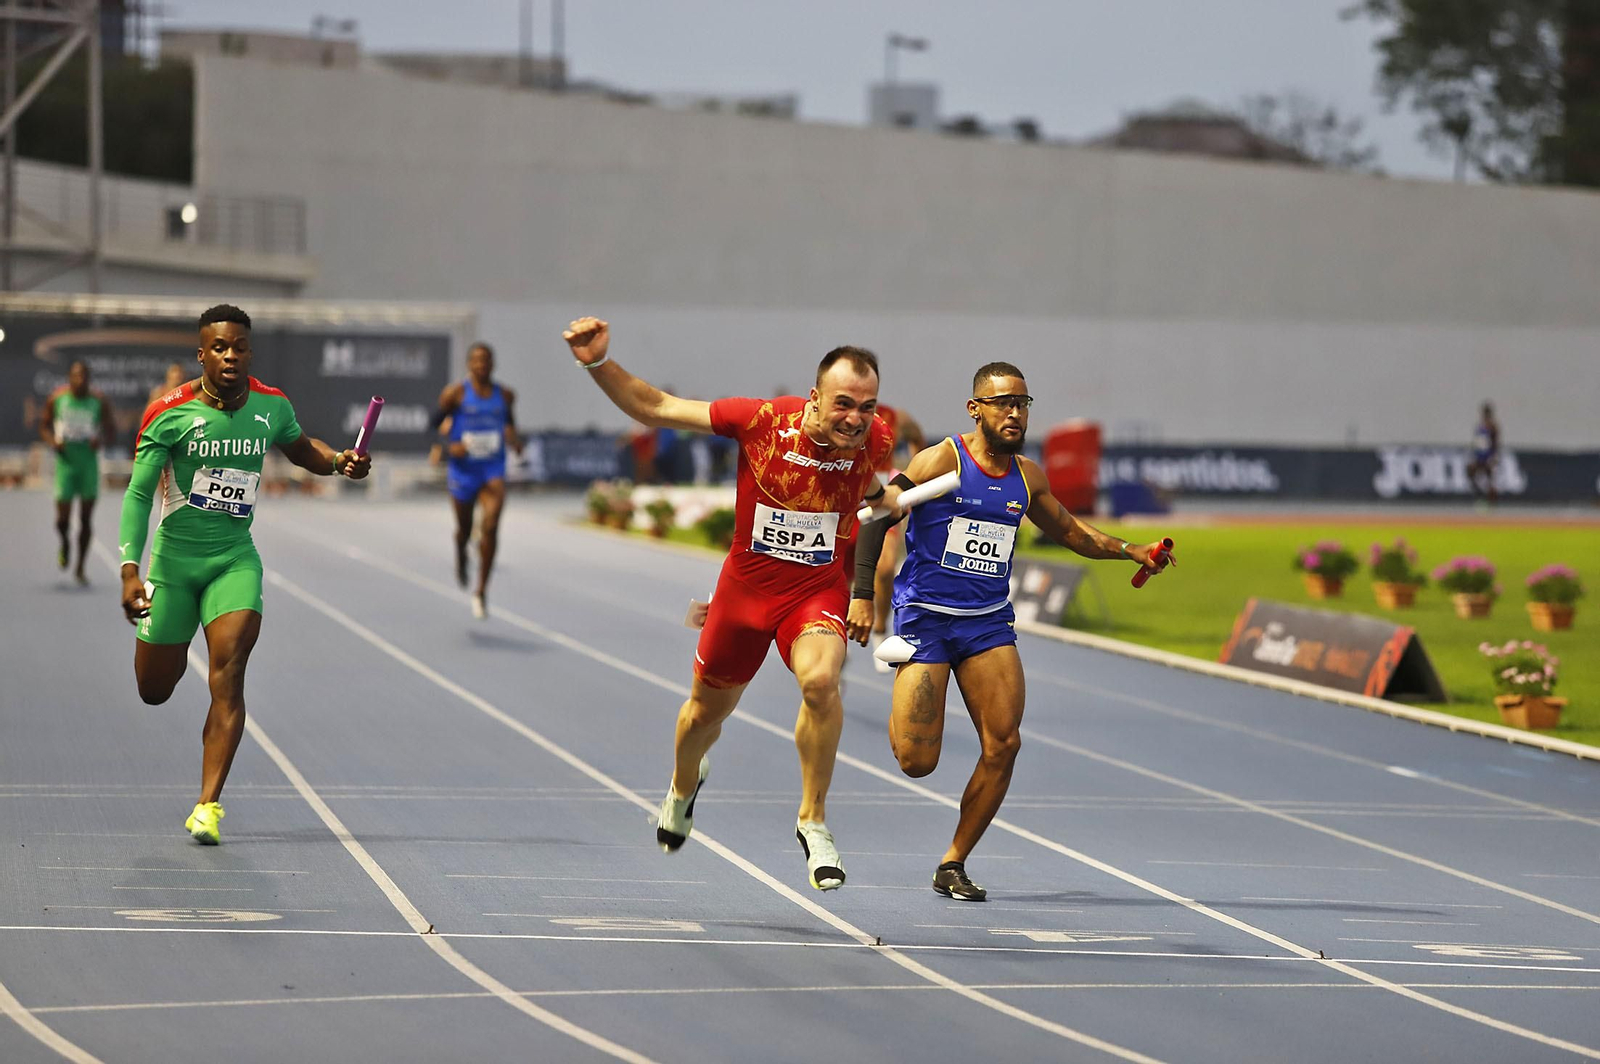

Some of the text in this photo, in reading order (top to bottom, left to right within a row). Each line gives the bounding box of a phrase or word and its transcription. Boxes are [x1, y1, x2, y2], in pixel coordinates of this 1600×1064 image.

[187, 438, 267, 457] PORTUGAL
[782, 450, 854, 472] ESPAÑA
[208, 482, 245, 500] POR
[771, 512, 785, 523] H
[967, 522, 980, 533] H
[762, 527, 826, 547] ESP A
[965, 539, 1000, 558] COL
[958, 557, 998, 573] Joma
